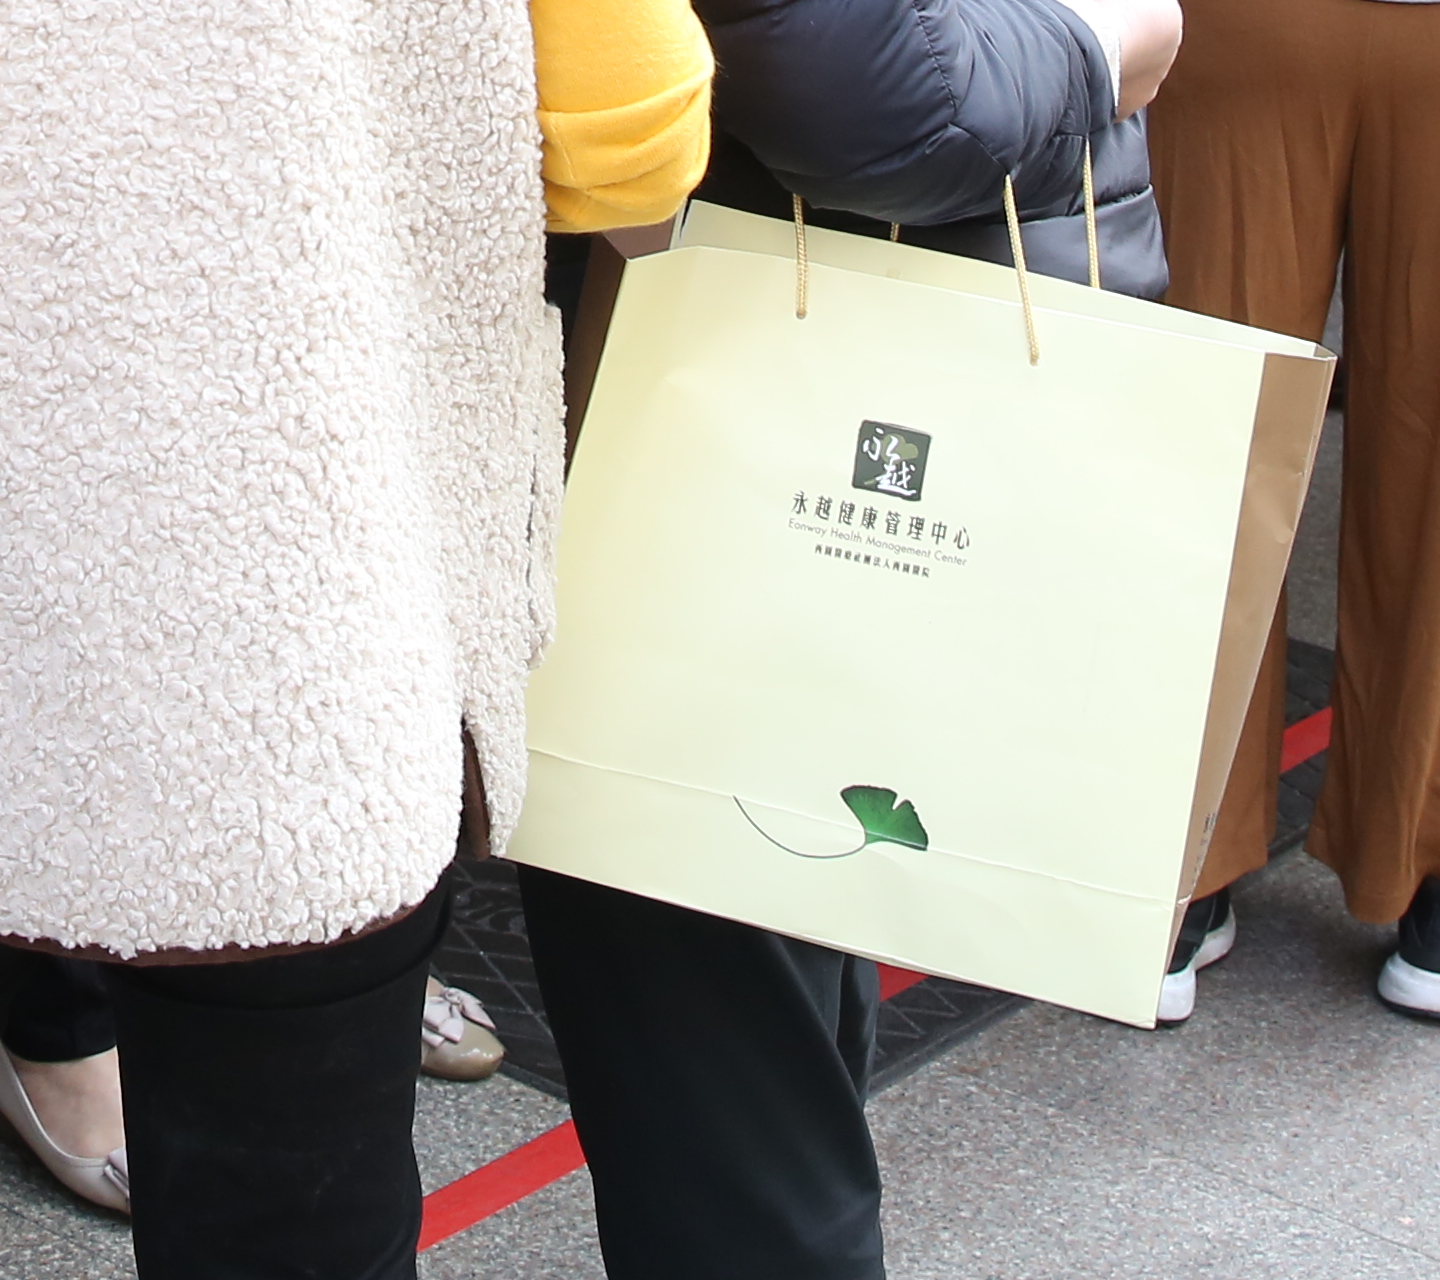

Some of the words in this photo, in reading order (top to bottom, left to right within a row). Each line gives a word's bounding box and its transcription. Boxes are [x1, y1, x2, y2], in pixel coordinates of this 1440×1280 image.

[787, 517, 828, 538] Eonway
[830, 526, 863, 544] Health
[865, 536, 932, 558] Management
[934, 549, 968, 567] Center
[791, 490, 971, 551] 永越健康管理中心
